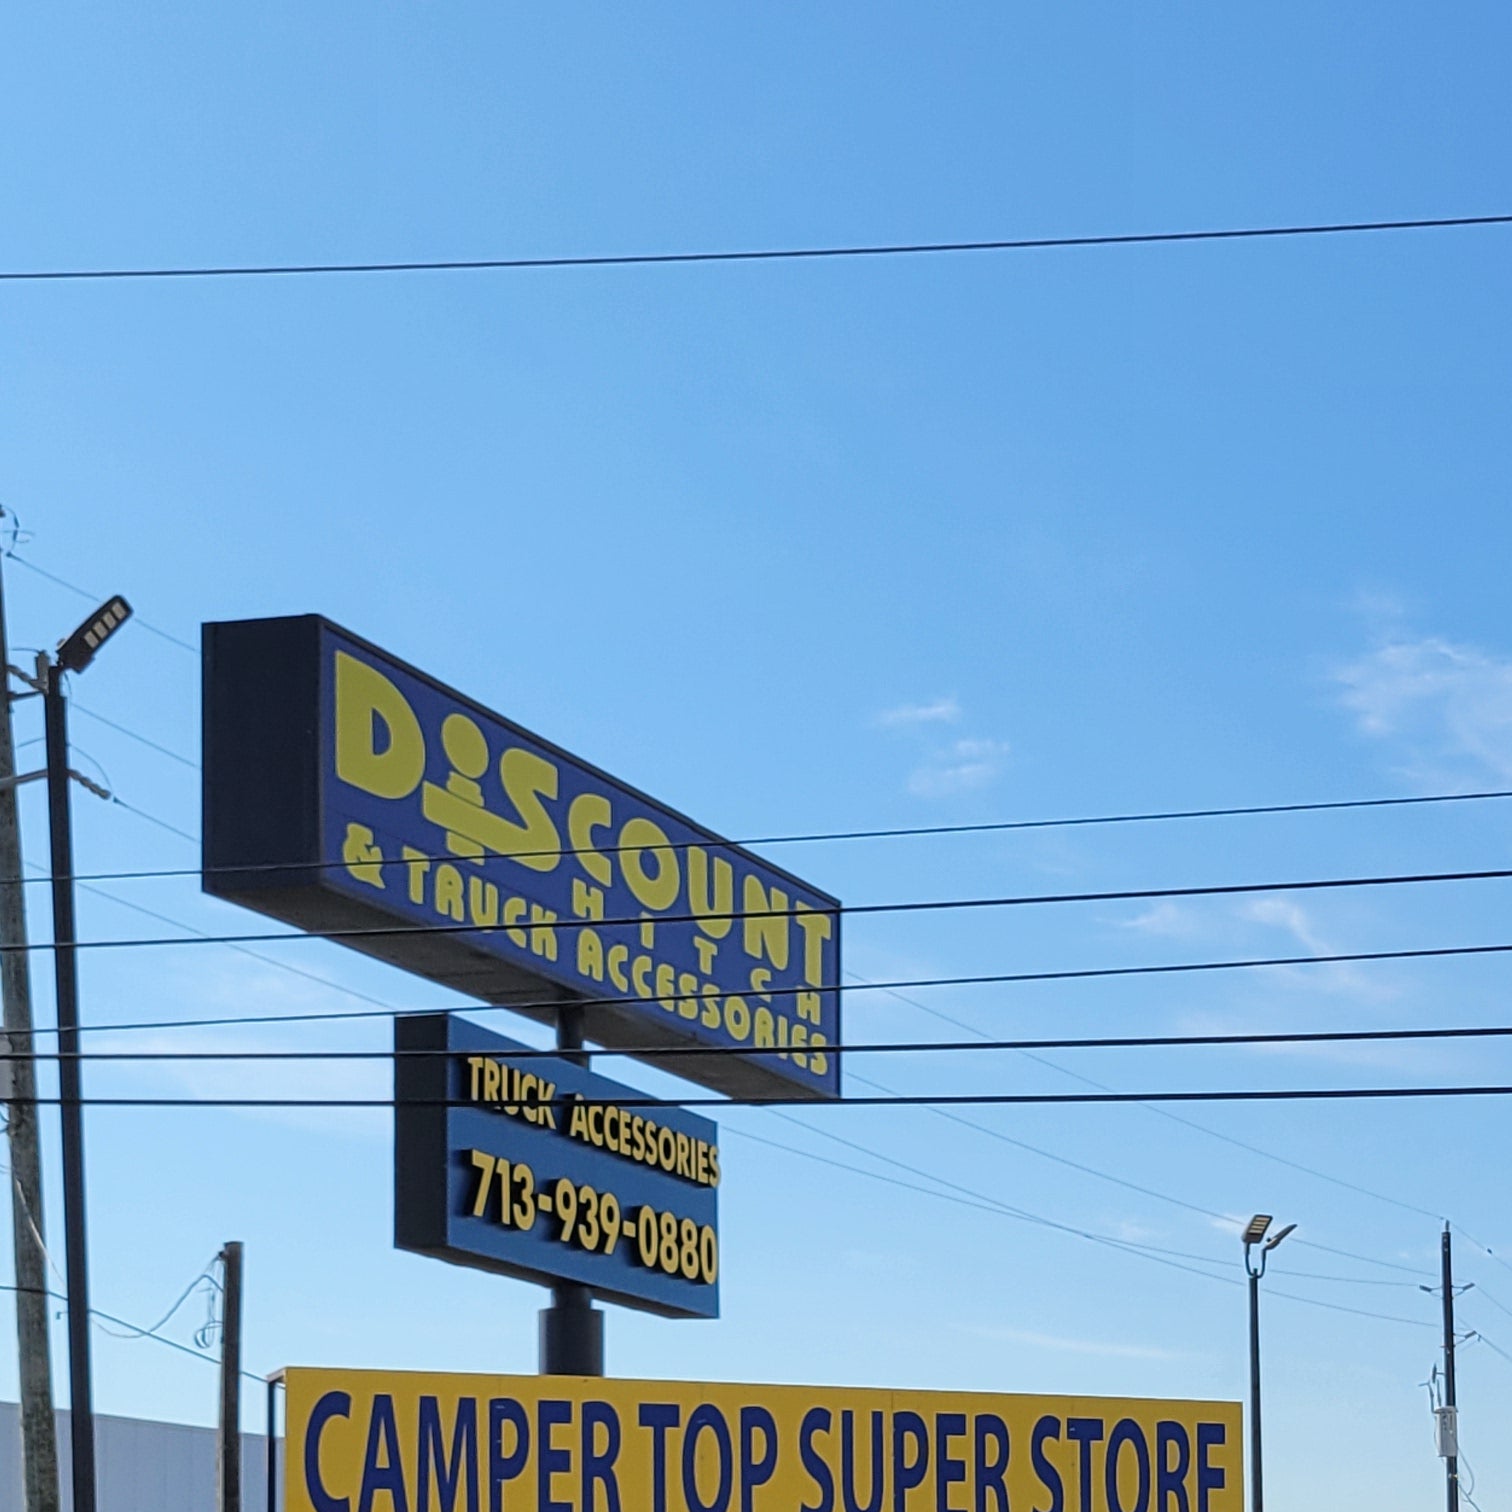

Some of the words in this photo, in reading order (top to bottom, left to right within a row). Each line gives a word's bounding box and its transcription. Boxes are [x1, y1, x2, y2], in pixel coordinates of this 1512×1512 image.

[342, 823, 386, 889] &
[402, 848, 559, 962] TRUCK
[576, 930, 829, 1075] ACCESSORIES
[467, 1056, 558, 1131] TRUCK
[569, 1093, 722, 1189] ACCESSORIES
[470, 1149, 719, 1286] 713-939-0880
